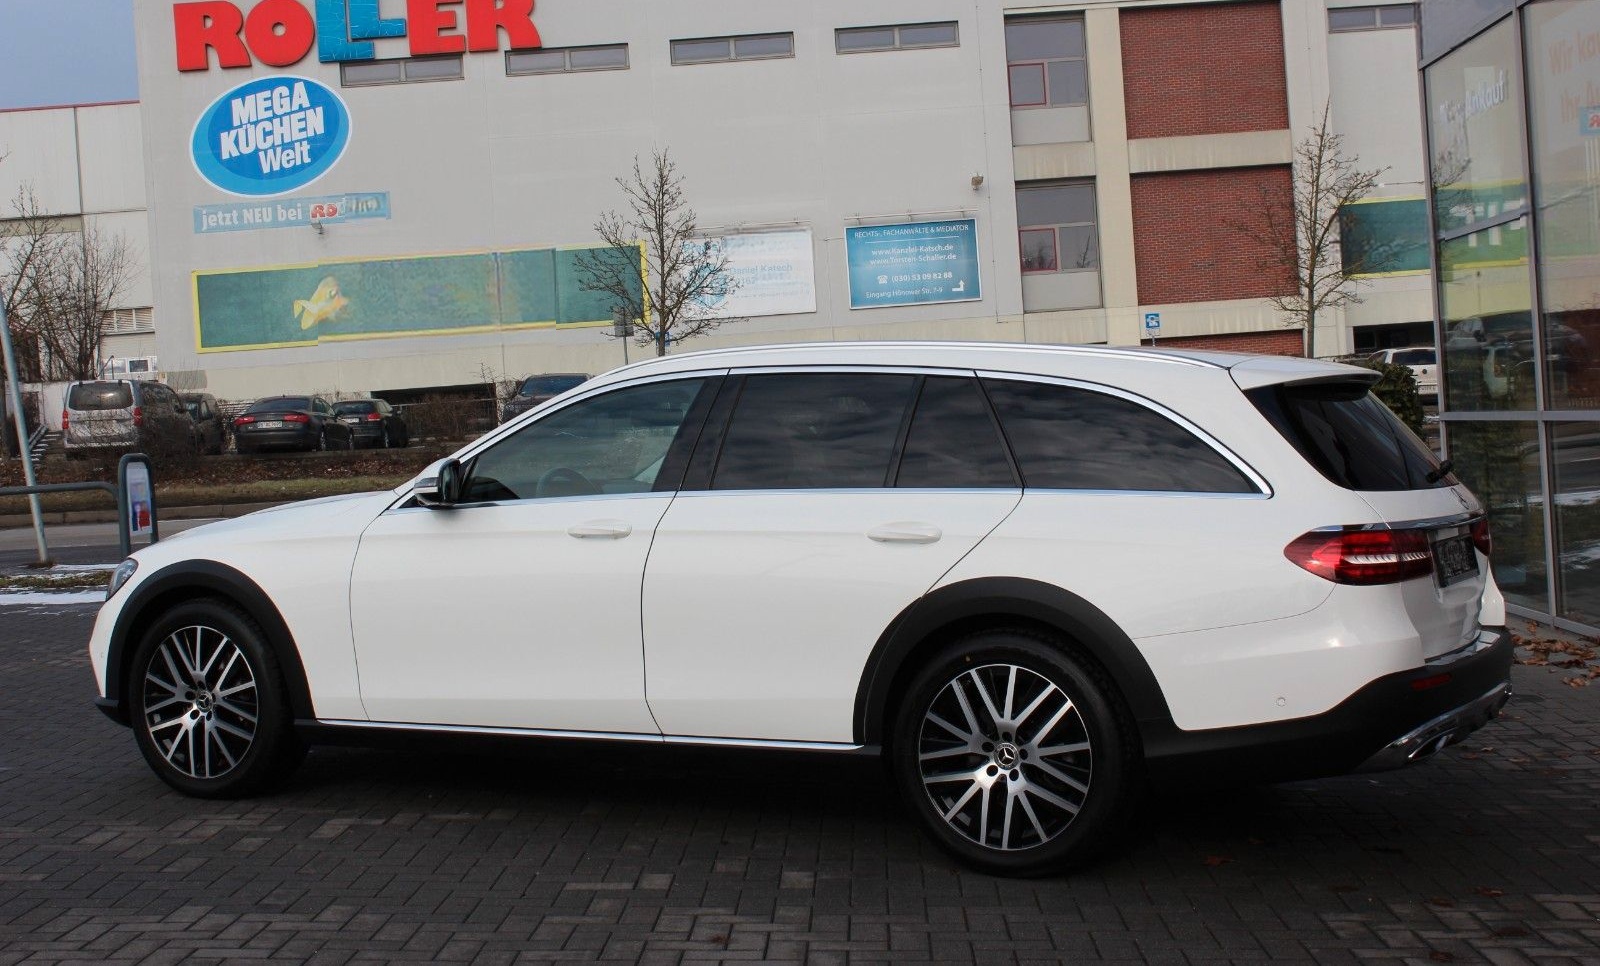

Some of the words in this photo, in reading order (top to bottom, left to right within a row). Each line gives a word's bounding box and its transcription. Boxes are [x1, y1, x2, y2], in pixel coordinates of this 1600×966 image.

[174, 0, 541, 72] ROLLER
[231, 81, 310, 127] MEGA
[220, 106, 324, 160] KÜCHEN
[258, 140, 311, 174] Welt
[202, 207, 239, 231] jetzt
[243, 206, 272, 224] NEU
[277, 203, 302, 221] bei
[936, 224, 969, 233] MEDIATOR
